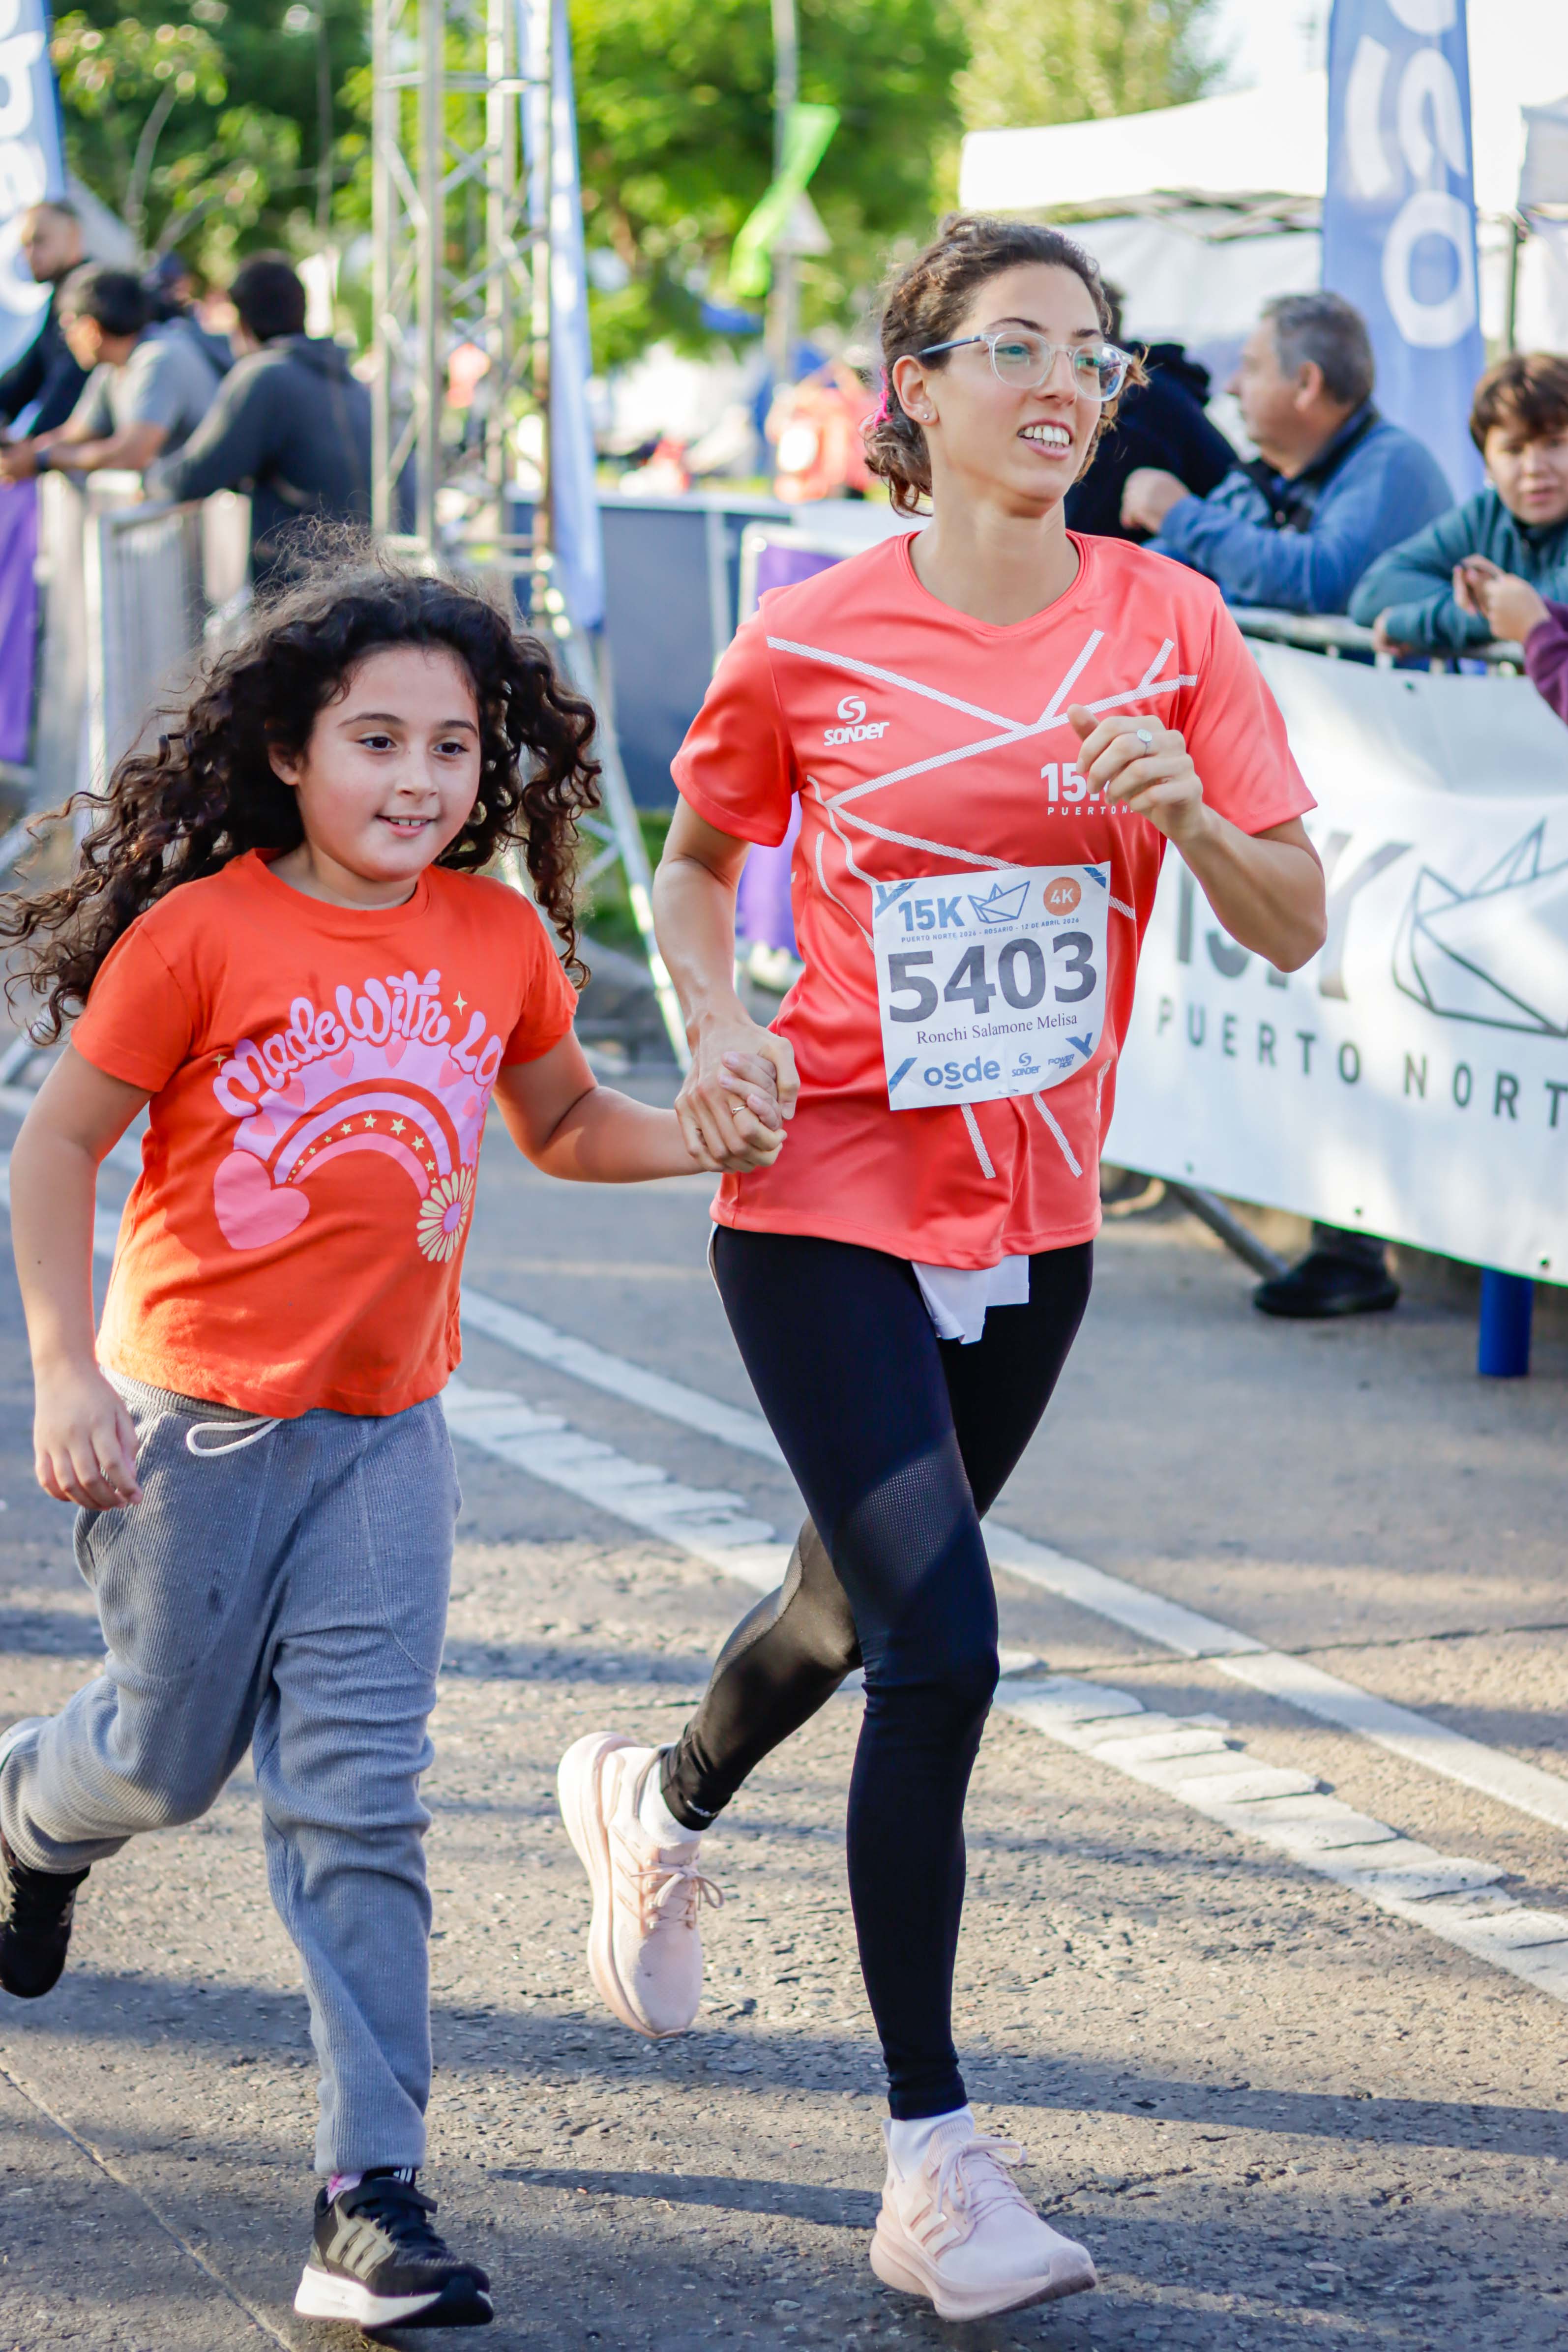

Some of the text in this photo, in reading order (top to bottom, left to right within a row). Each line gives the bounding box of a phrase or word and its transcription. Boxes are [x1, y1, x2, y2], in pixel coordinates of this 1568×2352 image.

[1040, 762, 1110, 802] 15
[1050, 888, 1074, 904] 4K
[898, 896, 966, 932] 15K
[984, 926, 1013, 935] ROSARIO
[888, 931, 1097, 1023] 5403
[917, 1013, 1078, 1044] Ronchi Salamone Melisa
[923, 1055, 1001, 1088] osde
[1048, 1054, 1075, 1065] POWER
[1156, 997, 1568, 1128] PUERTO NORT
